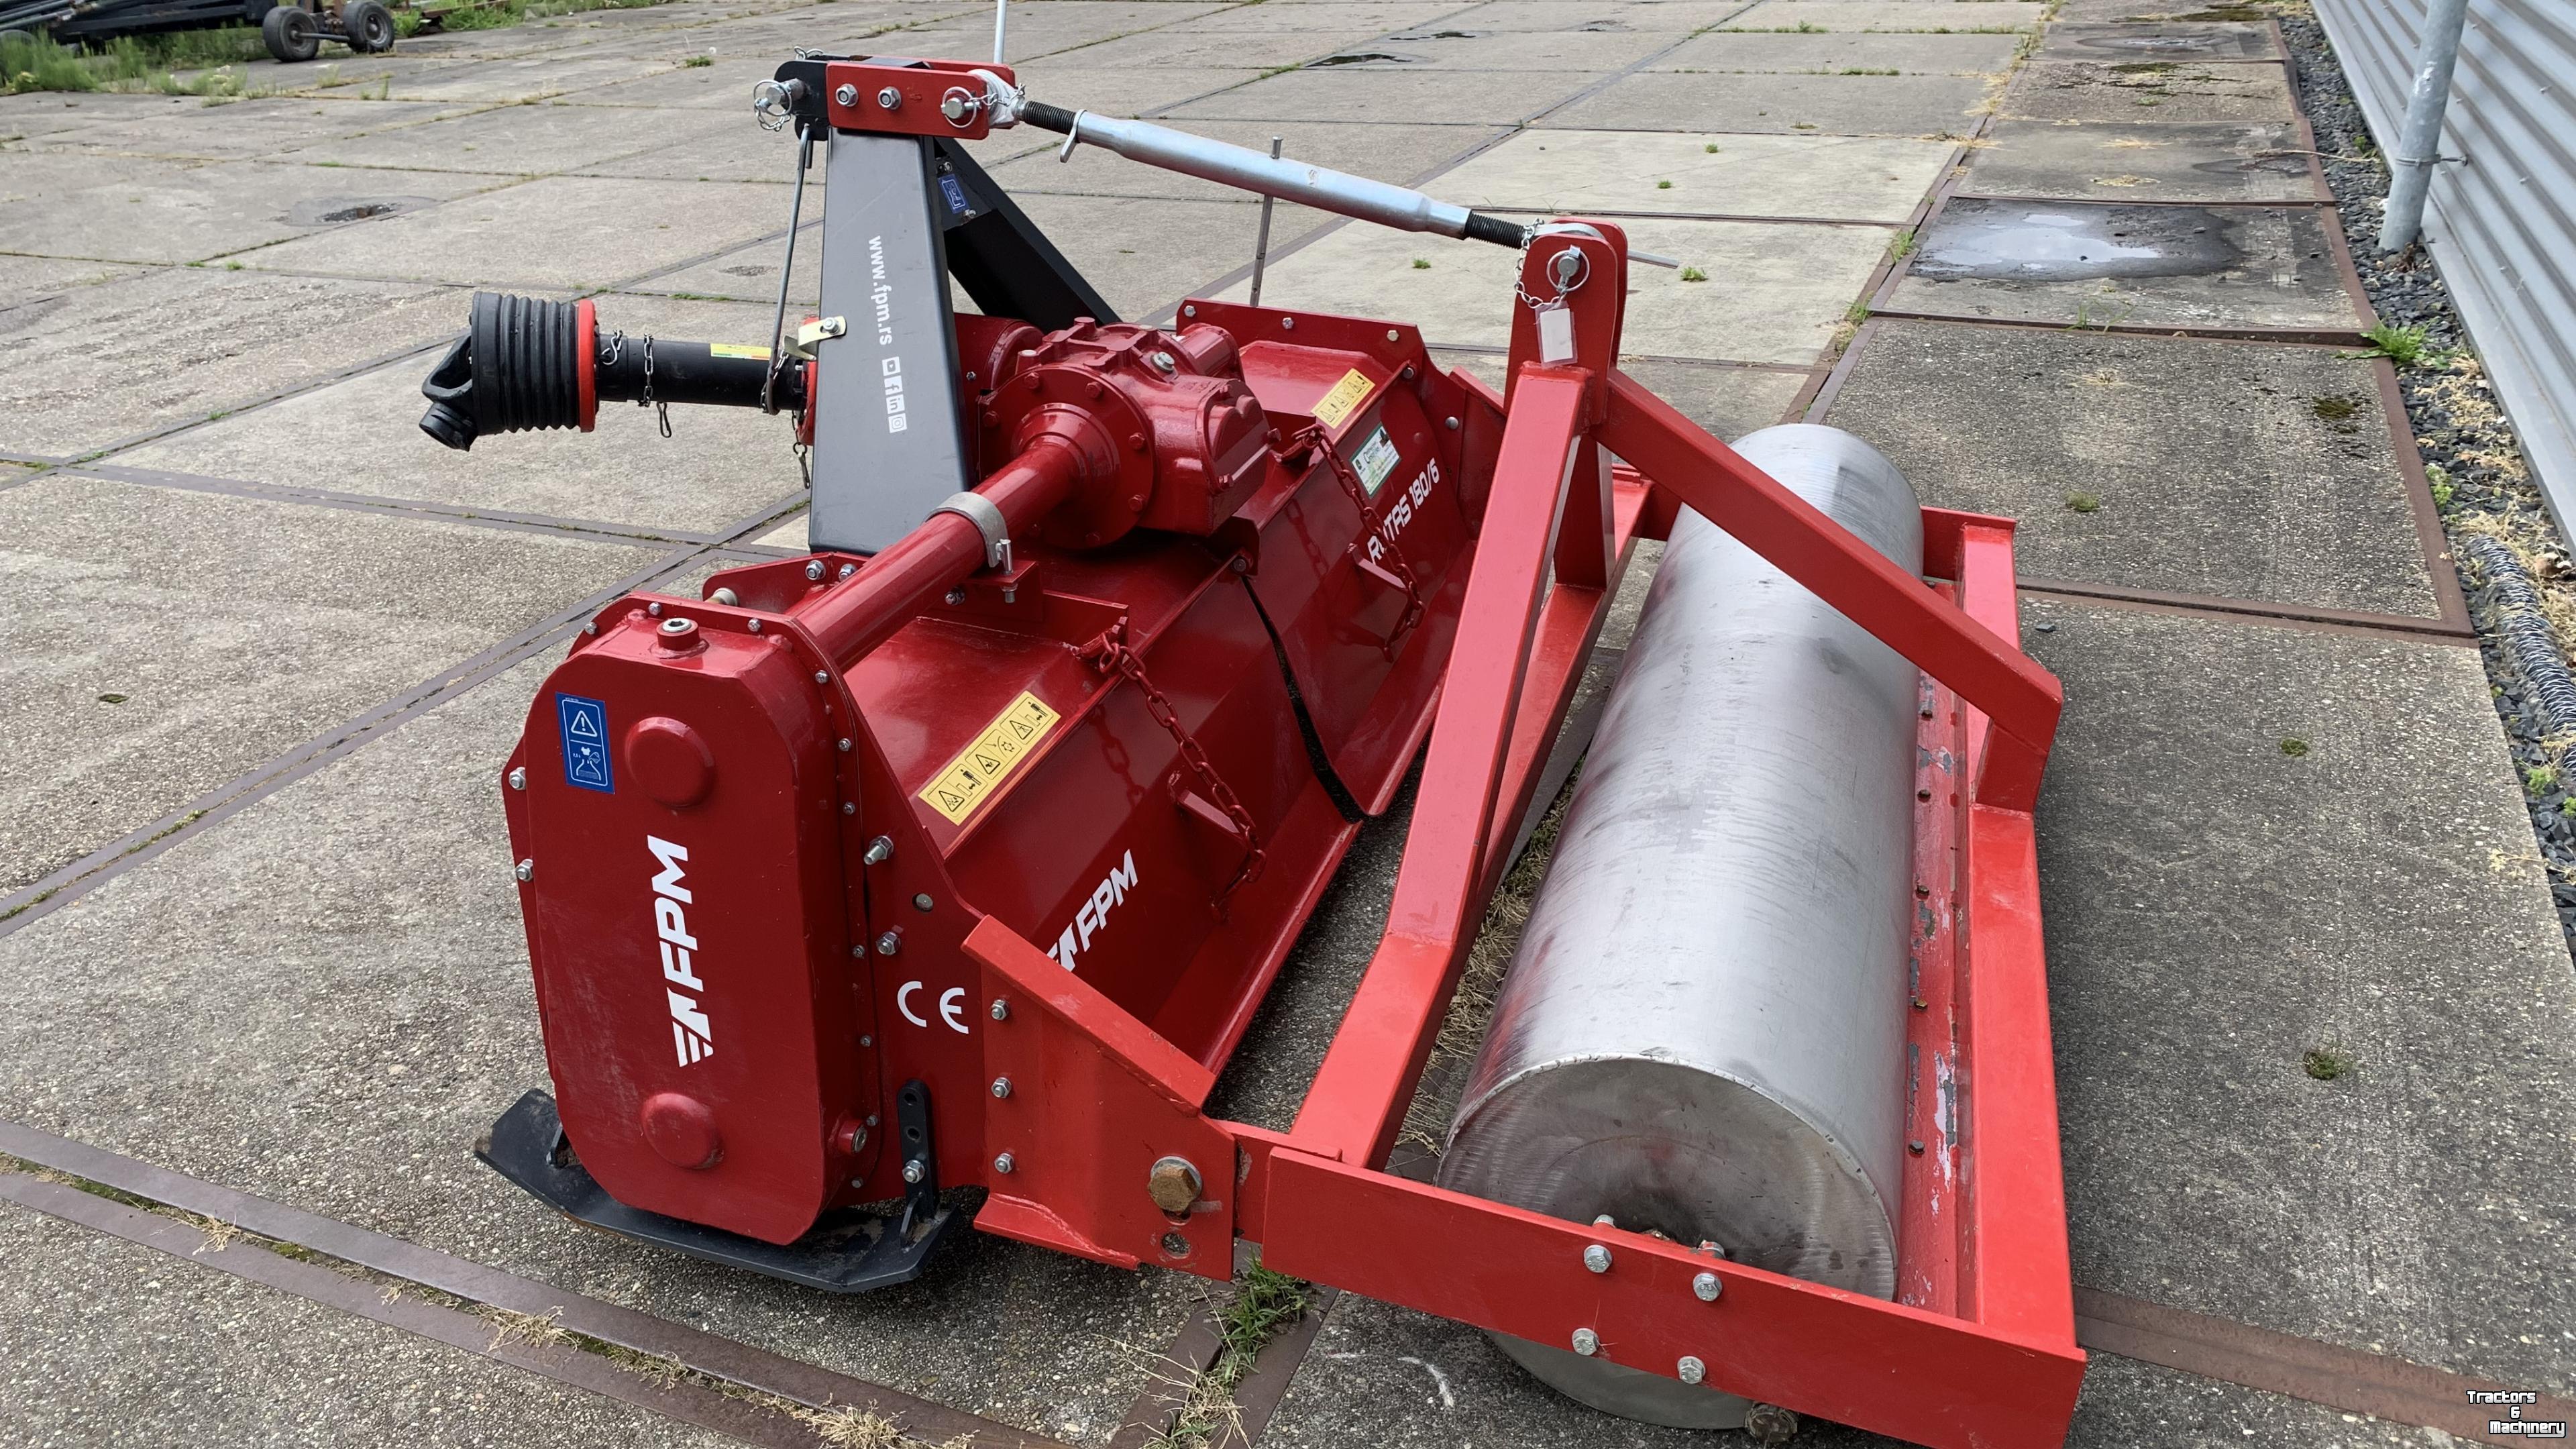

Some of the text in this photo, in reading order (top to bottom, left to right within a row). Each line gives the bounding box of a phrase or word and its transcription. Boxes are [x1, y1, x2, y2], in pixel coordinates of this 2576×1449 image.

[869, 235, 892, 345] www.fpm.rs
[1409, 458, 1440, 510] 180/6
[647, 835, 703, 991] FPM
[1075, 849, 1138, 952] FPM
[898, 981, 969, 1034] CE
